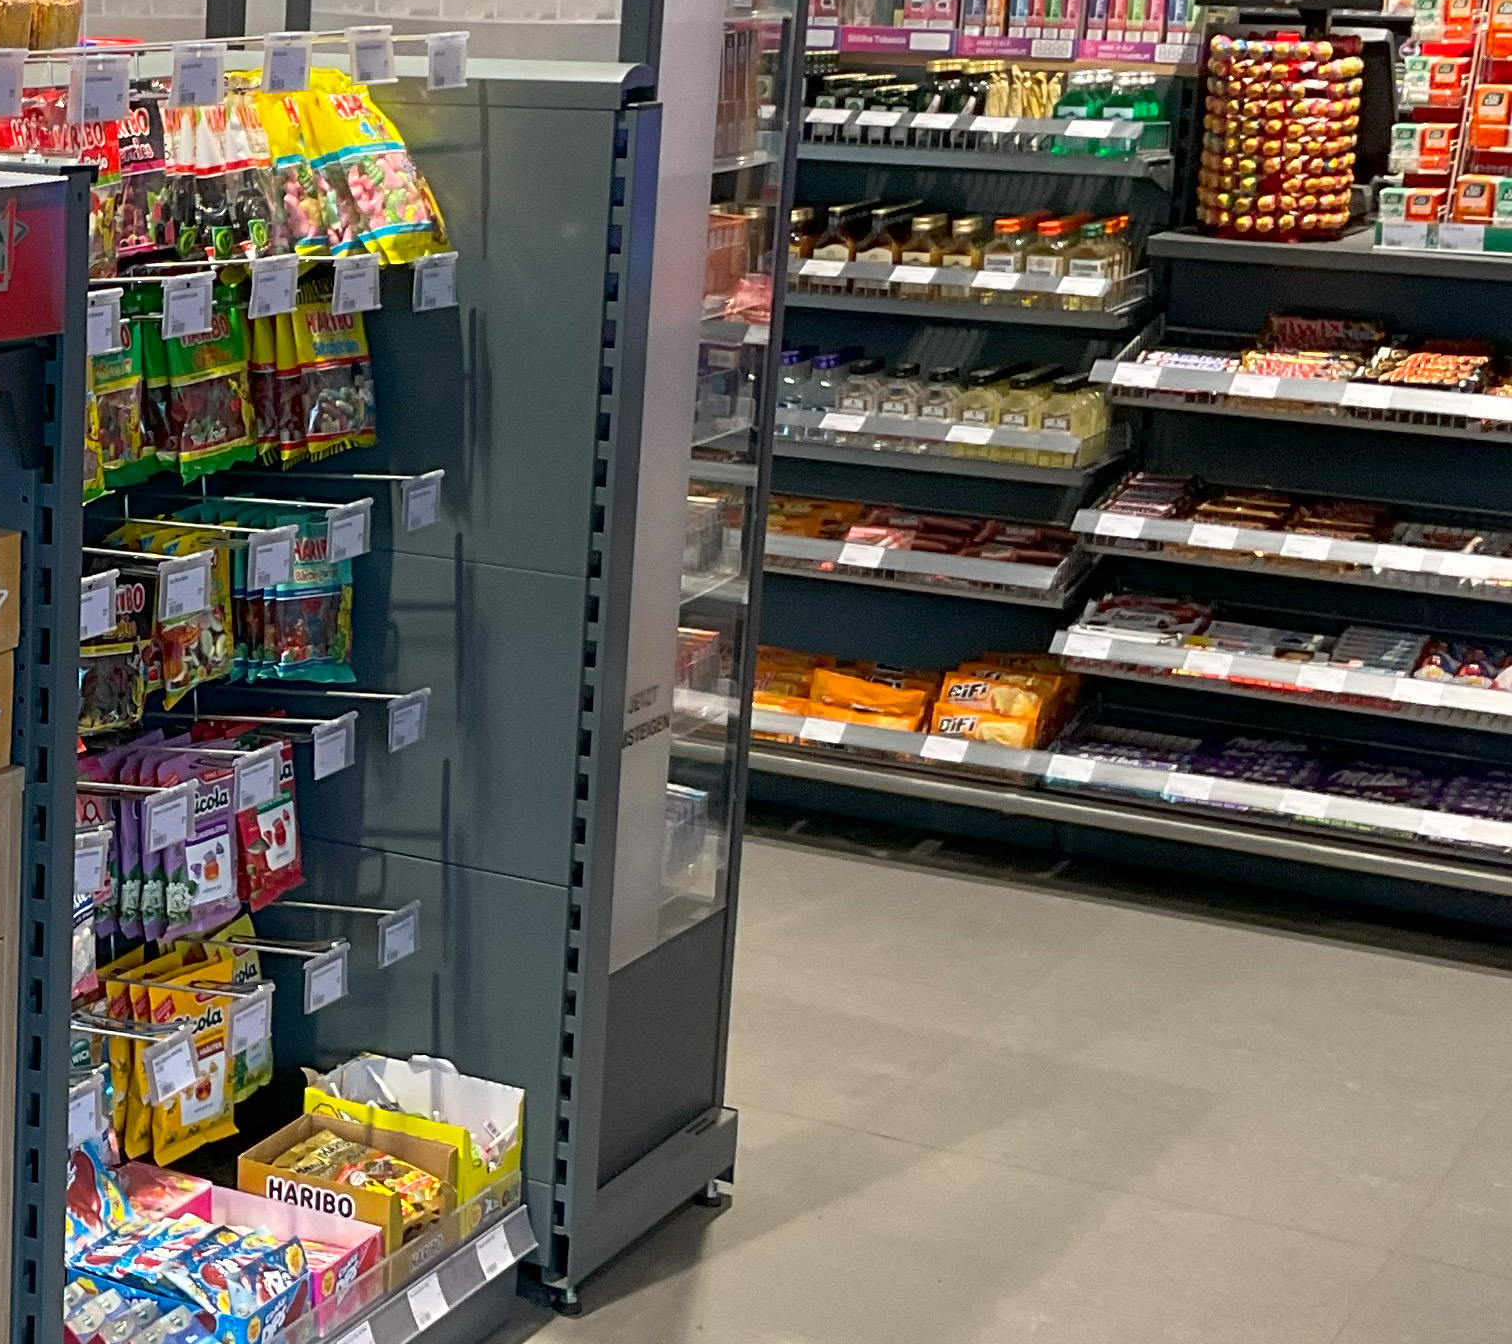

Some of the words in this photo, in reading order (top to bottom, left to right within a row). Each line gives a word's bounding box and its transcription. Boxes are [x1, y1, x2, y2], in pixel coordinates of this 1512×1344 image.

[193, 787, 229, 815] icola
[234, 962, 258, 983] cola
[268, 1178, 354, 1219] HARIBO
